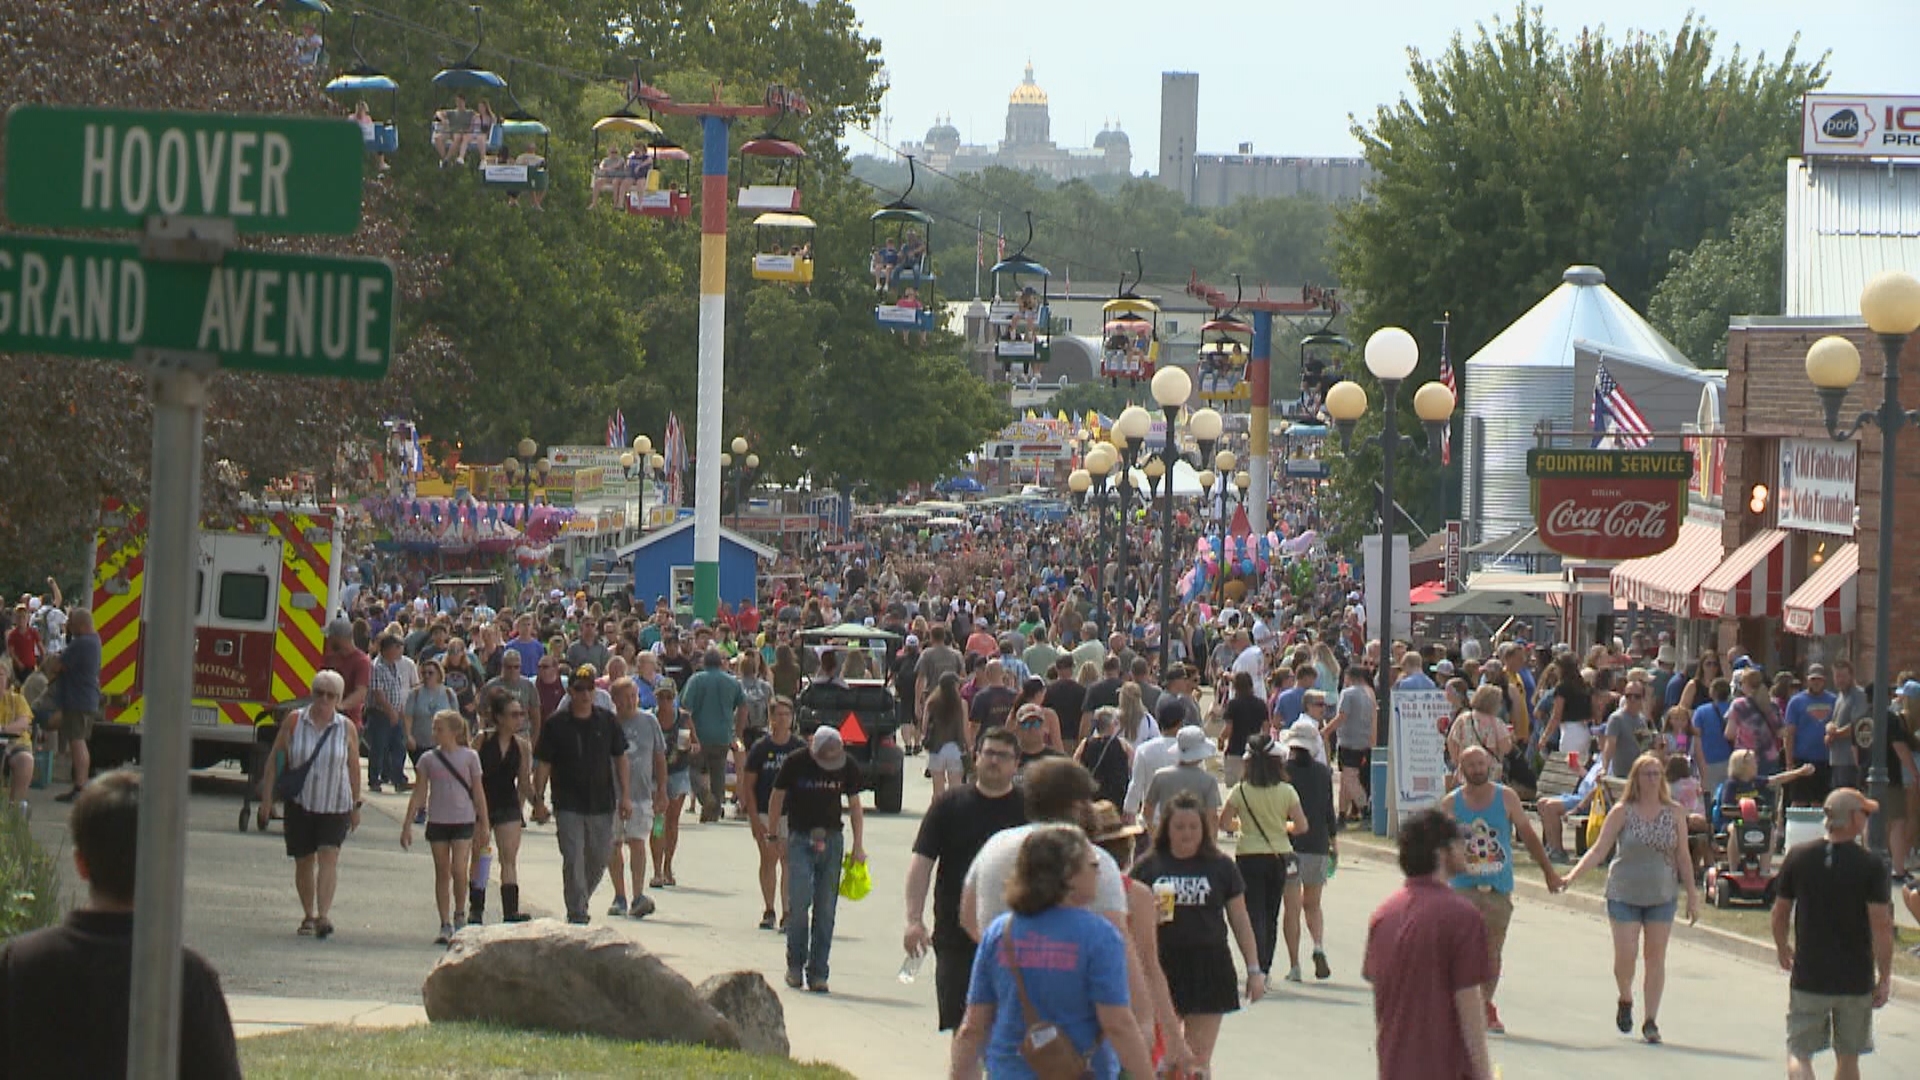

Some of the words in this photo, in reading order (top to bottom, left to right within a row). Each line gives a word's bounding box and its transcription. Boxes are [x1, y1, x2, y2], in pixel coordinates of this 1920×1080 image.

[1827, 115, 1857, 135] pork
[80, 124, 292, 217] HOOVER
[197, 266, 385, 363] AVENUE
[1536, 454, 1614, 473] FOUNTAIN
[1620, 455, 1686, 473] SERVICE
[1796, 446, 1810, 479] Old
[1810, 446, 1856, 485] Fashioned
[1591, 488, 1623, 497] DRINK
[1792, 487, 1813, 522] Soda
[1813, 488, 1855, 526] Fountain
[1448, 531, 1459, 582] BEEF
